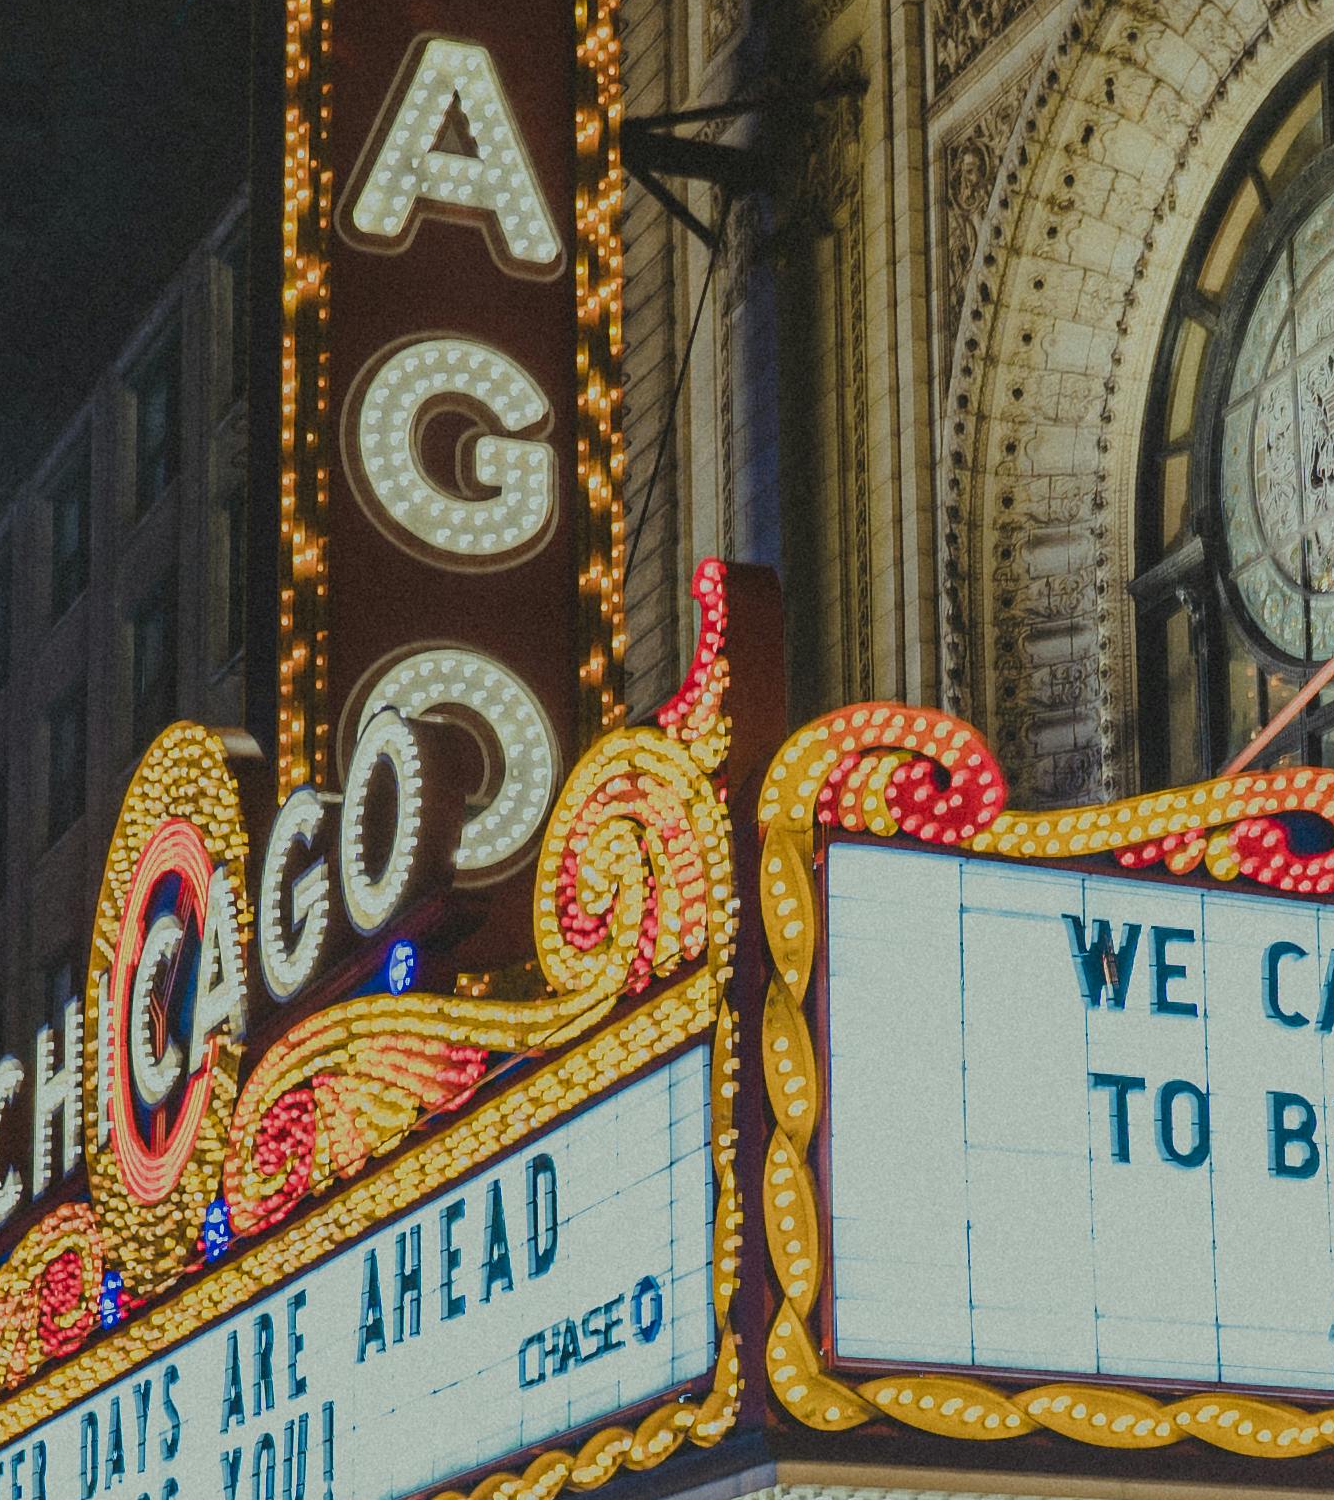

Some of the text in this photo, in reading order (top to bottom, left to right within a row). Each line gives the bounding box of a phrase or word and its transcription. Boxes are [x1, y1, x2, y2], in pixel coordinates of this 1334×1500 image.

[1062, 913, 1199, 1018] WE
[1088, 1072, 1210, 1168] TO
[79, 1364, 180, 1500] DAYS
[219, 1288, 308, 1434] ARE
[356, 1152, 560, 1363] AHEAD
[518, 1294, 627, 1390] CHASE
